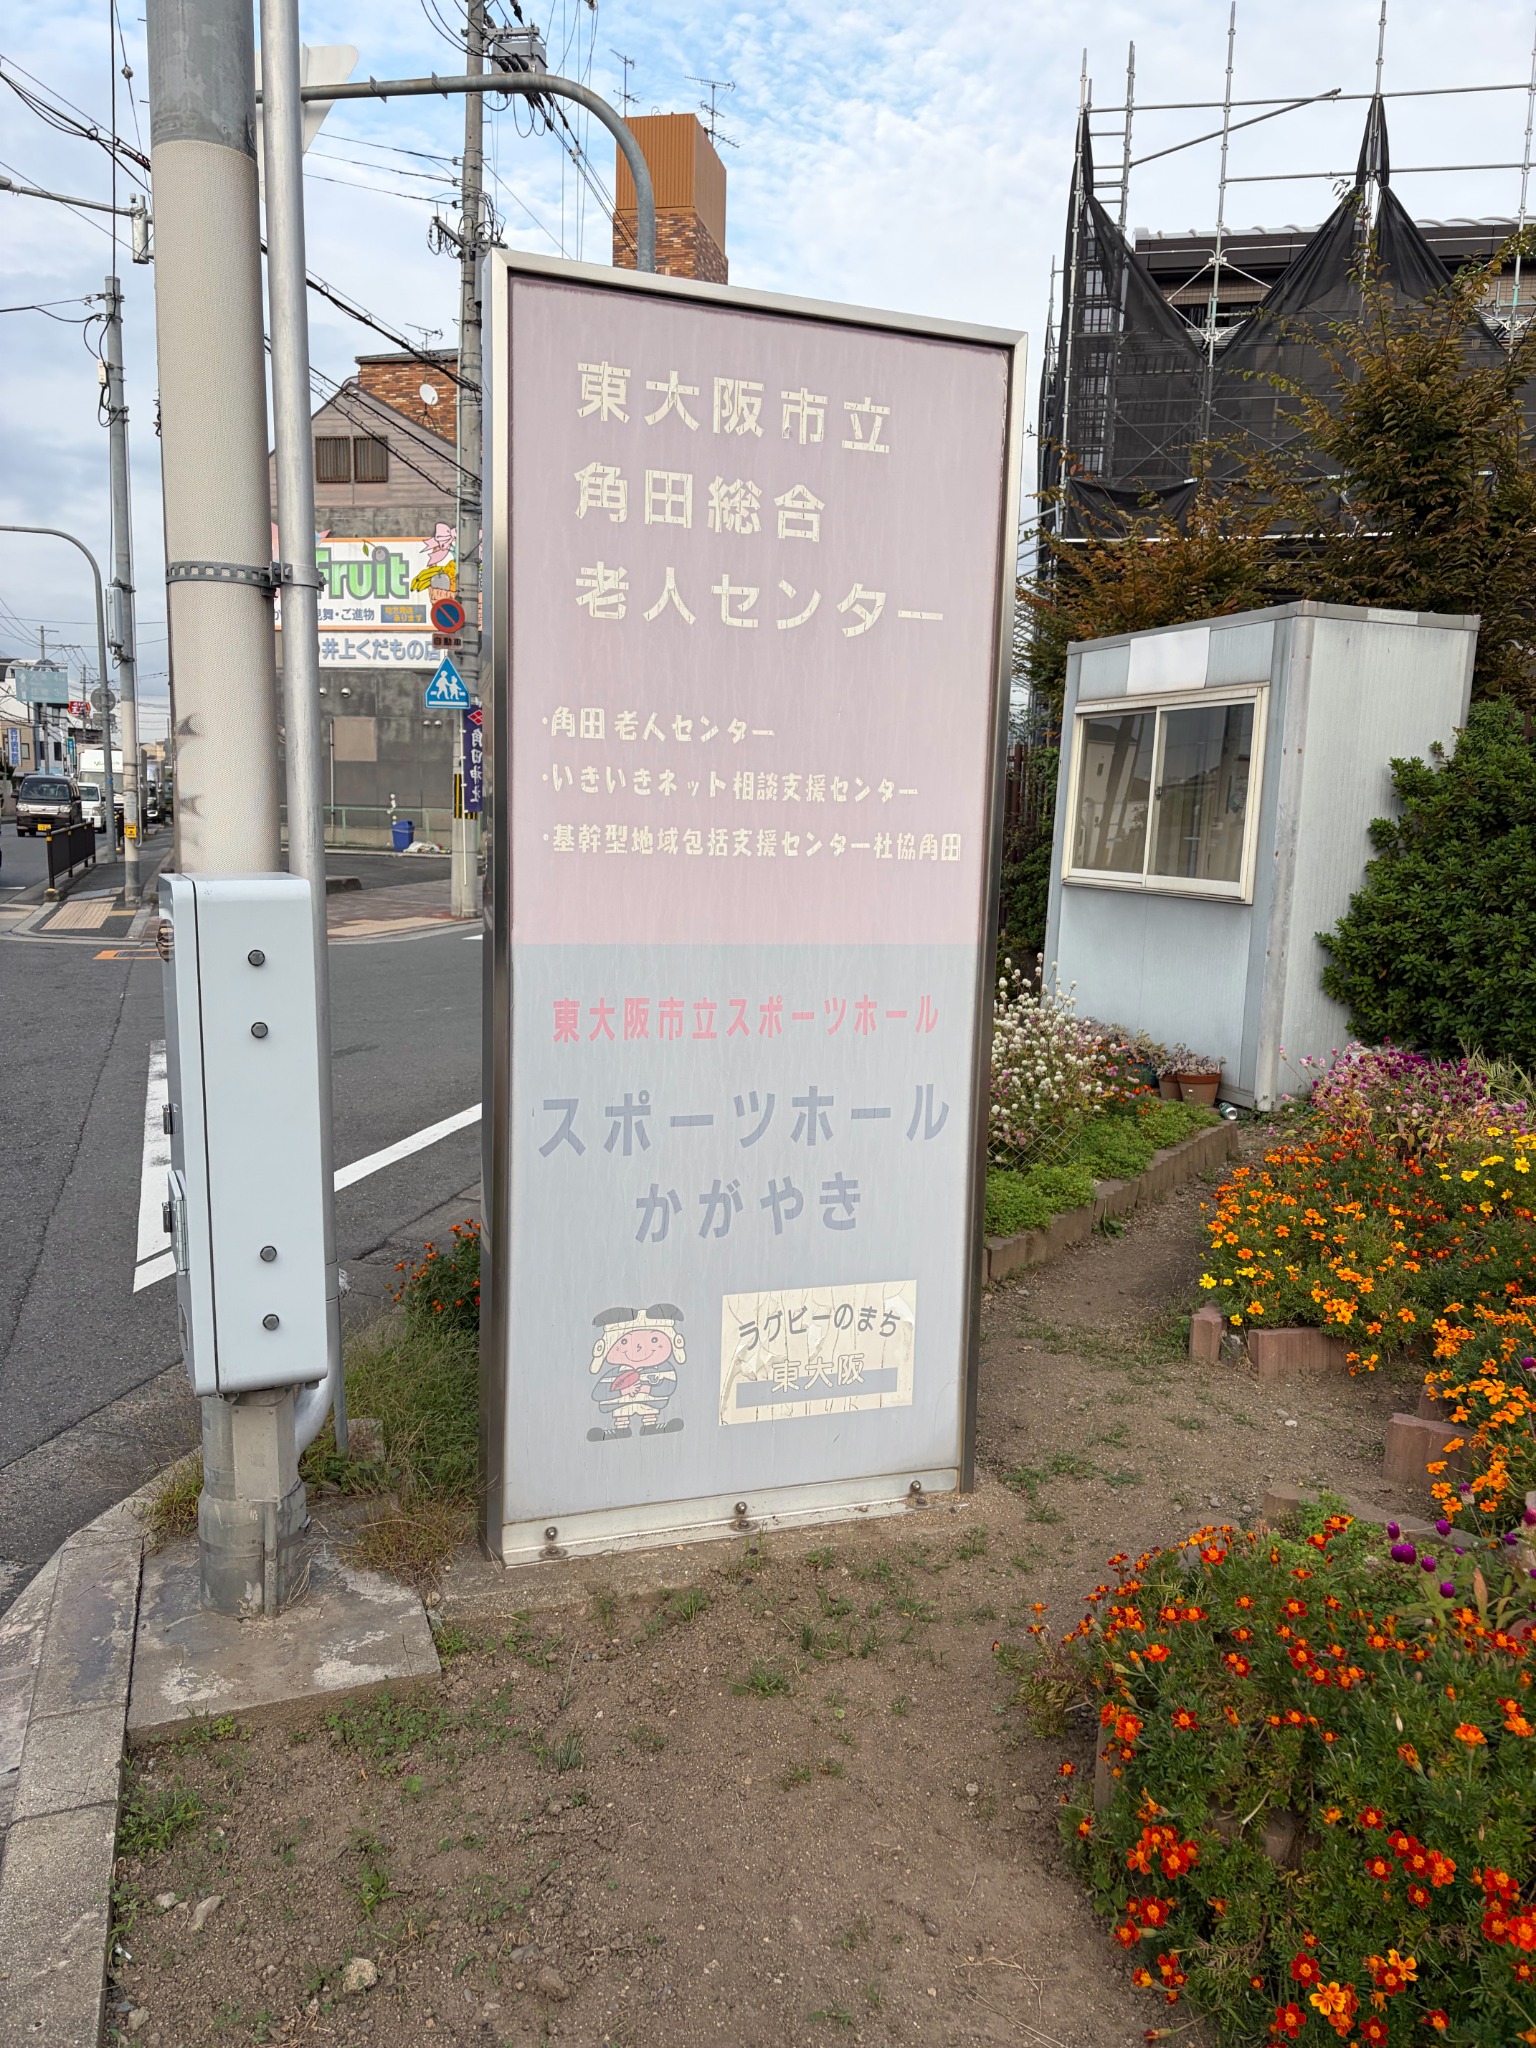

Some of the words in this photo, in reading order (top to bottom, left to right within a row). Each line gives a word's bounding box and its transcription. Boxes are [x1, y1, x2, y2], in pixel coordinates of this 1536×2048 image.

[576, 361, 891, 454] 東大阪市立
[573, 462, 826, 542] 角田総合
[316, 547, 409, 600] Fruit
[575, 561, 944, 638] 老人センター
[552, 995, 940, 1043] 東大阪市立スポーツホール
[538, 1083, 950, 1158] スポーツホール
[635, 1171, 862, 1243] かがやき
[739, 1303, 900, 1350] ラグビーのまち
[772, 1353, 865, 1393] 東大阪
